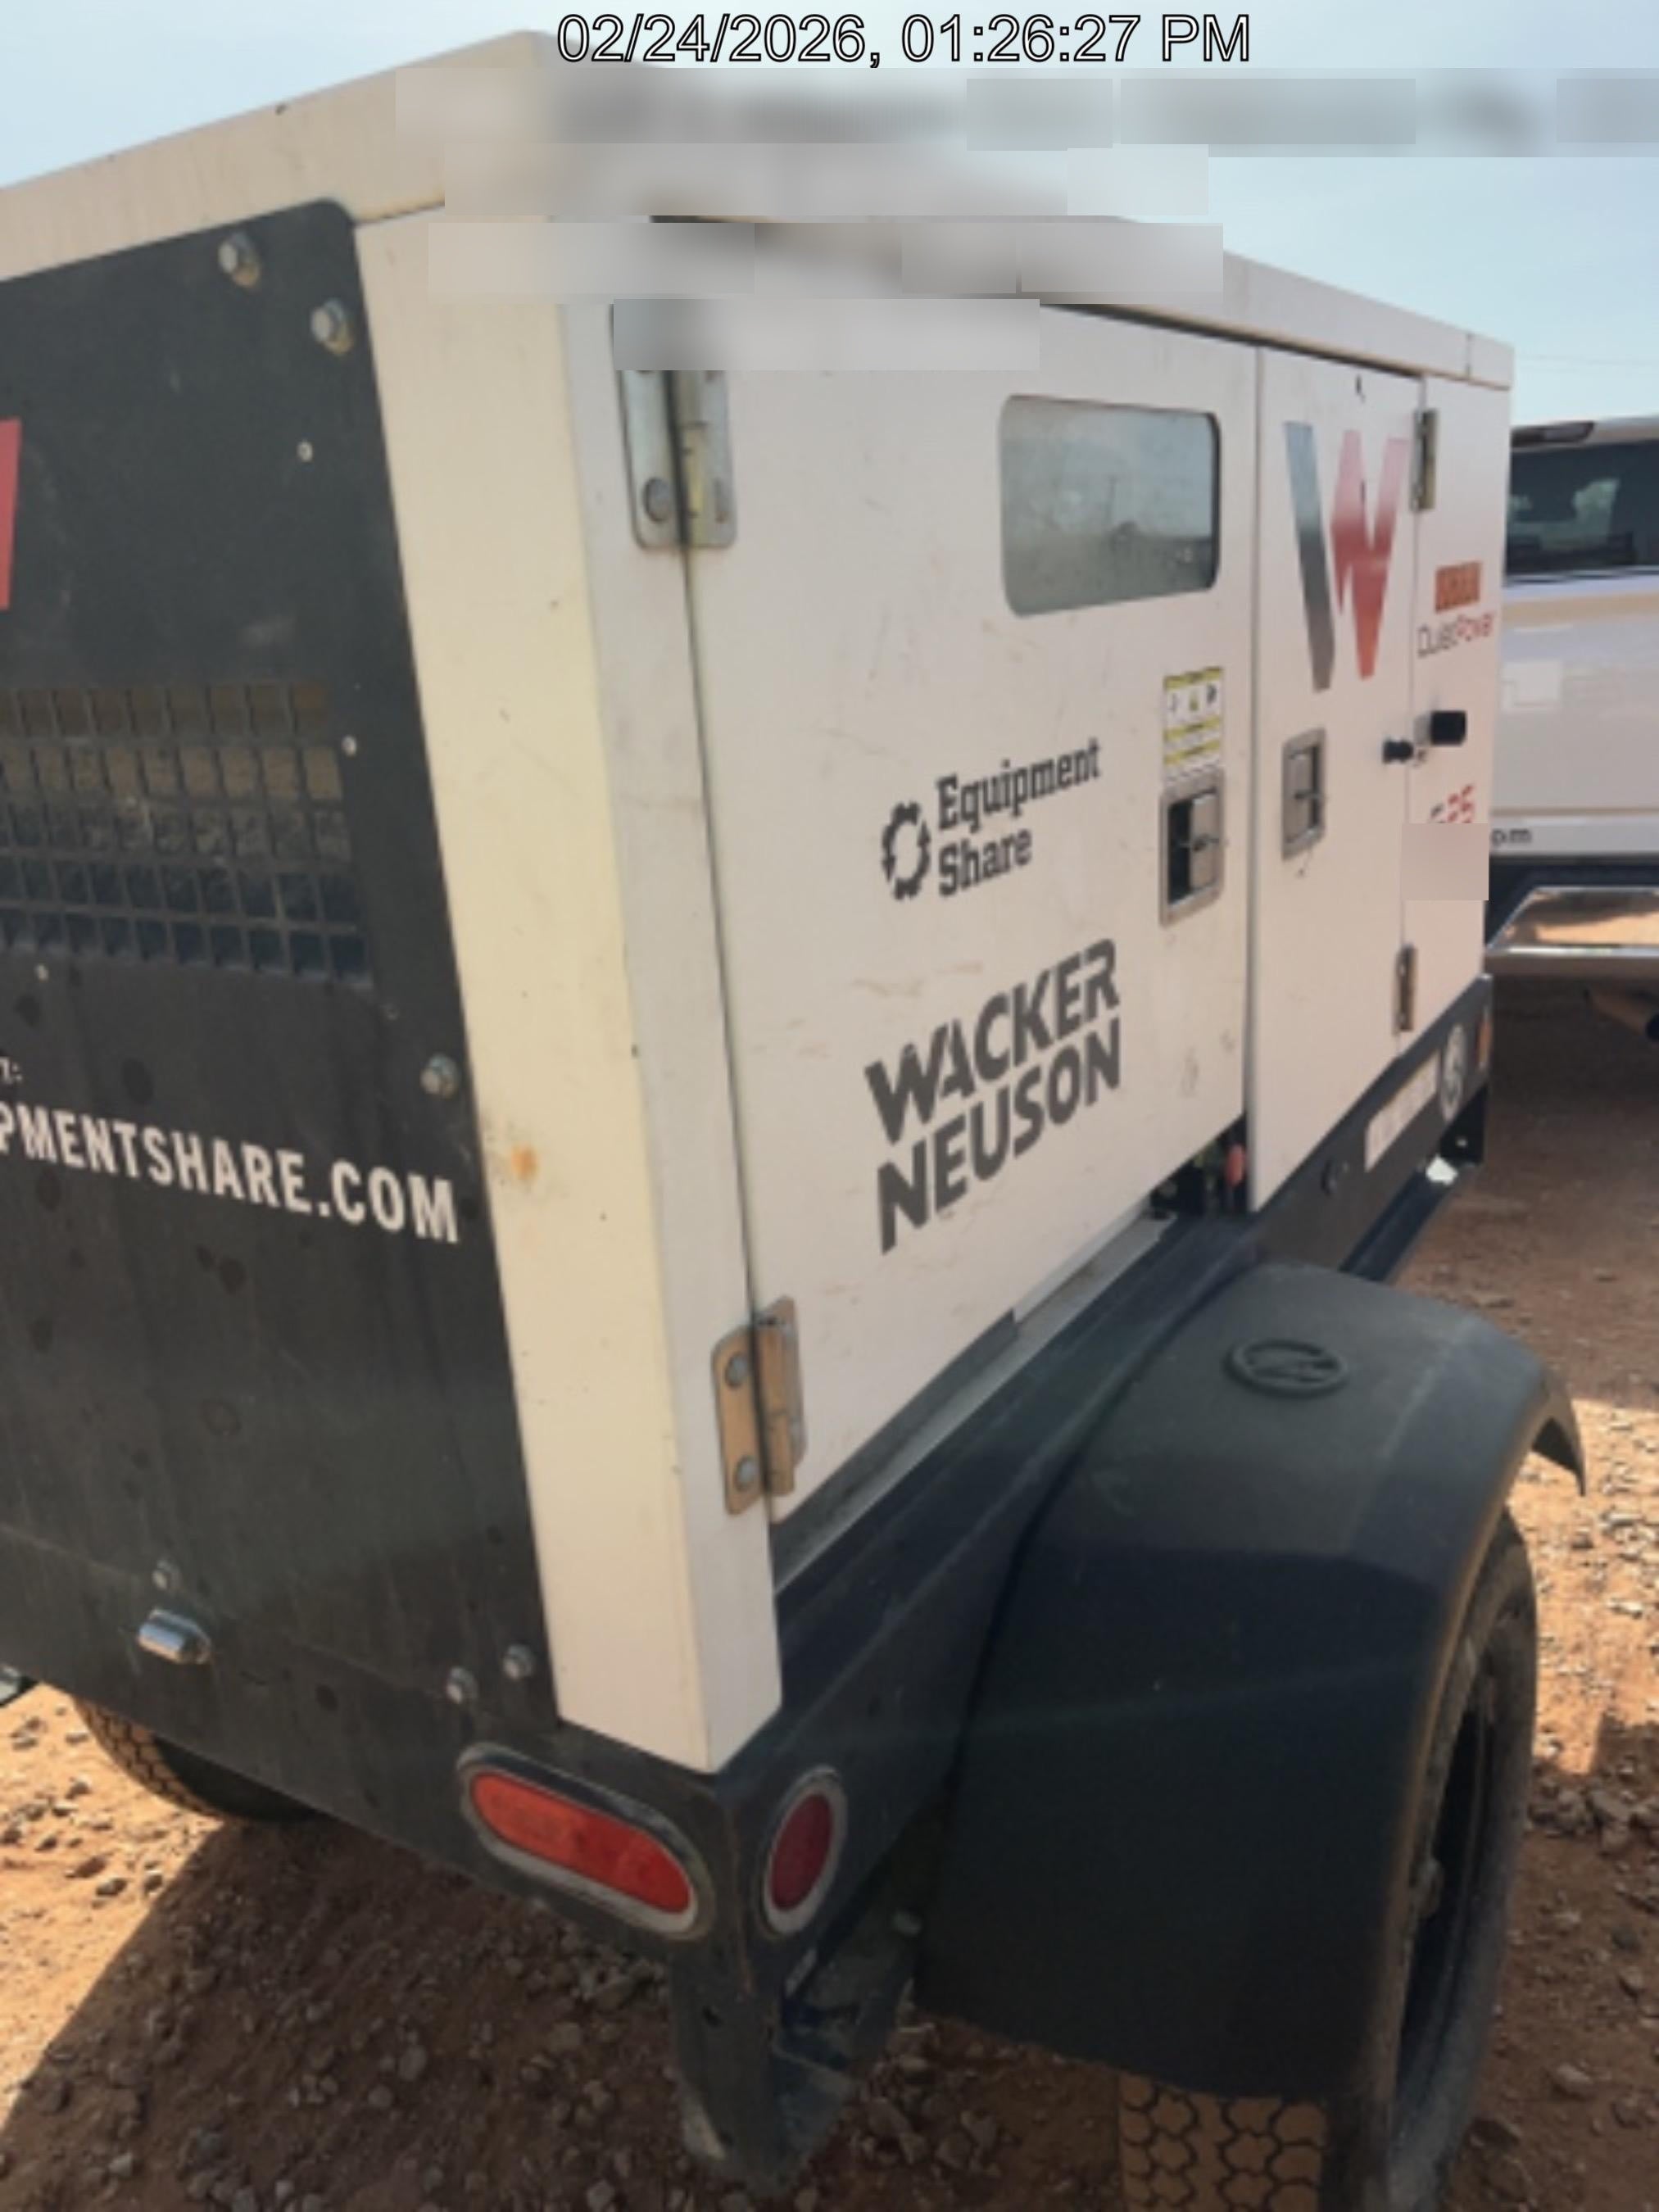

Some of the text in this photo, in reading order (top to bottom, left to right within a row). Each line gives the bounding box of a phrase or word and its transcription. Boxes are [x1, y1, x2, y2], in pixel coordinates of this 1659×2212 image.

[935, 737, 1101, 834] Equipment
[937, 827, 1032, 898] Share
[863, 937, 1120, 1147] WACKER
[877, 1016, 1121, 1255] NEUSON
